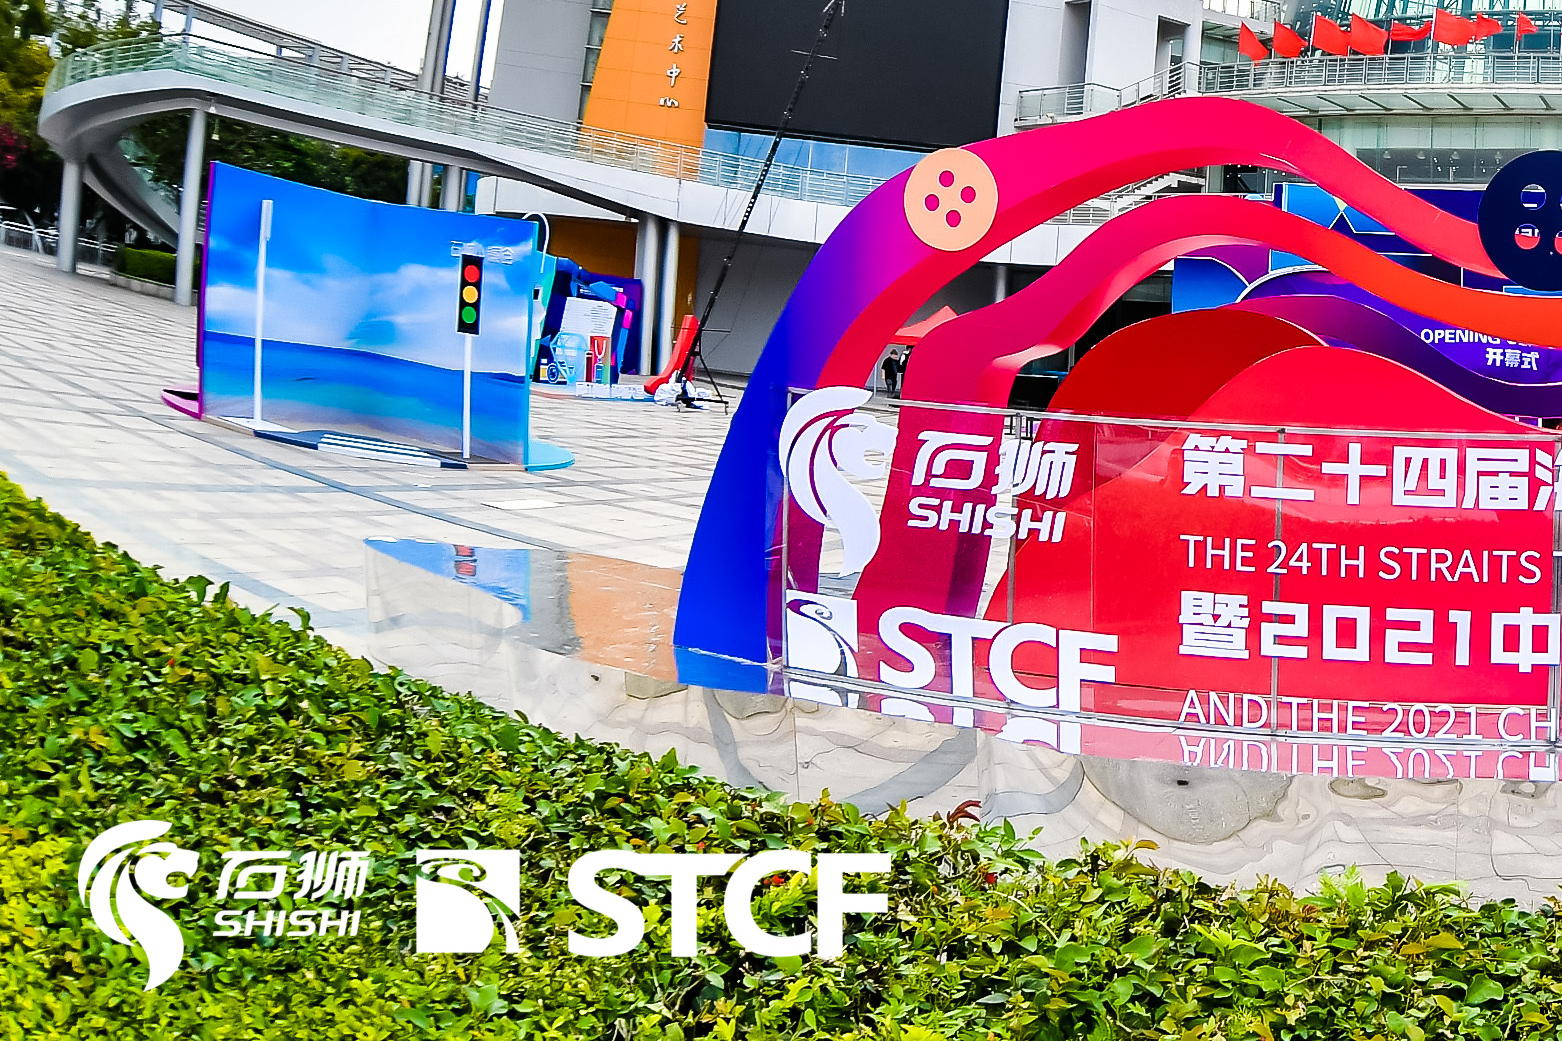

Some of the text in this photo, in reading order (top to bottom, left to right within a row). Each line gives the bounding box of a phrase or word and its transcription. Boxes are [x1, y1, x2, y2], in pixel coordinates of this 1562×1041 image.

[1420, 328, 1501, 344] OPENING
[1485, 347, 1540, 371] 开幕式
[911, 430, 1080, 500] 石狮
[907, 496, 1067, 543] SHISHI
[1179, 534, 1257, 572] THE
[1266, 540, 1366, 579] 24TH
[1378, 546, 1542, 584] STRAITS
[878, 605, 1119, 715] STCF
[1178, 689, 1269, 729] AND
[1281, 696, 1370, 736] THE
[1381, 703, 1483, 741] 2021
